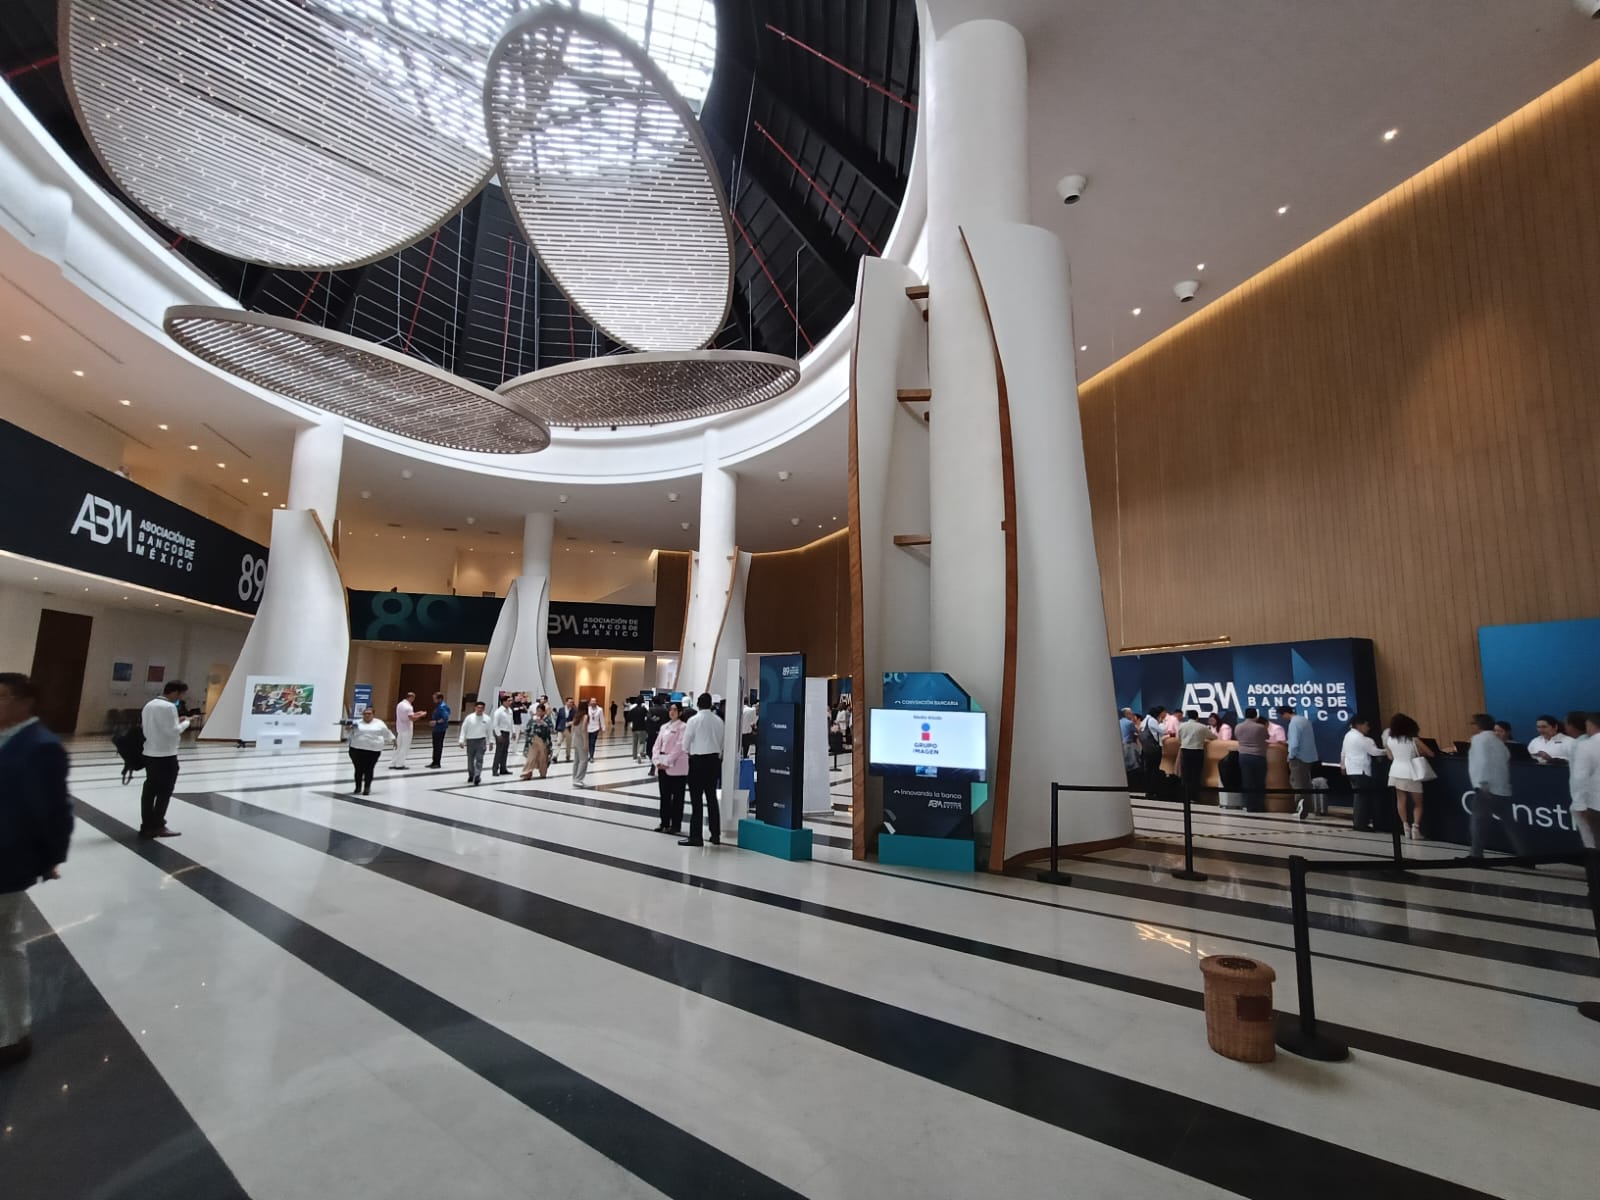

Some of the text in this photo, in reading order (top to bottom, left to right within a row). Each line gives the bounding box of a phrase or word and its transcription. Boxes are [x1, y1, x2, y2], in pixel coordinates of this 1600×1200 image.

[70, 493, 133, 553] ABM
[139, 519, 197, 550] ASOCIACIÓN DE
[137, 531, 195, 561] BANCOS DE
[135, 543, 193, 572] MÉXICO
[238, 554, 267, 602] 89
[547, 614, 579, 636] BM
[583, 617, 627, 625] ASOCIACIÓN
[583, 623, 627, 631] BANCOS
[582, 629, 638, 638] MÉXICO
[1247, 681, 1346, 695] ASOCIACIÓN DE
[1181, 682, 1244, 719] ABM
[1247, 696, 1348, 708] BANCOS DE
[1254, 706, 1349, 722] ÉICO
